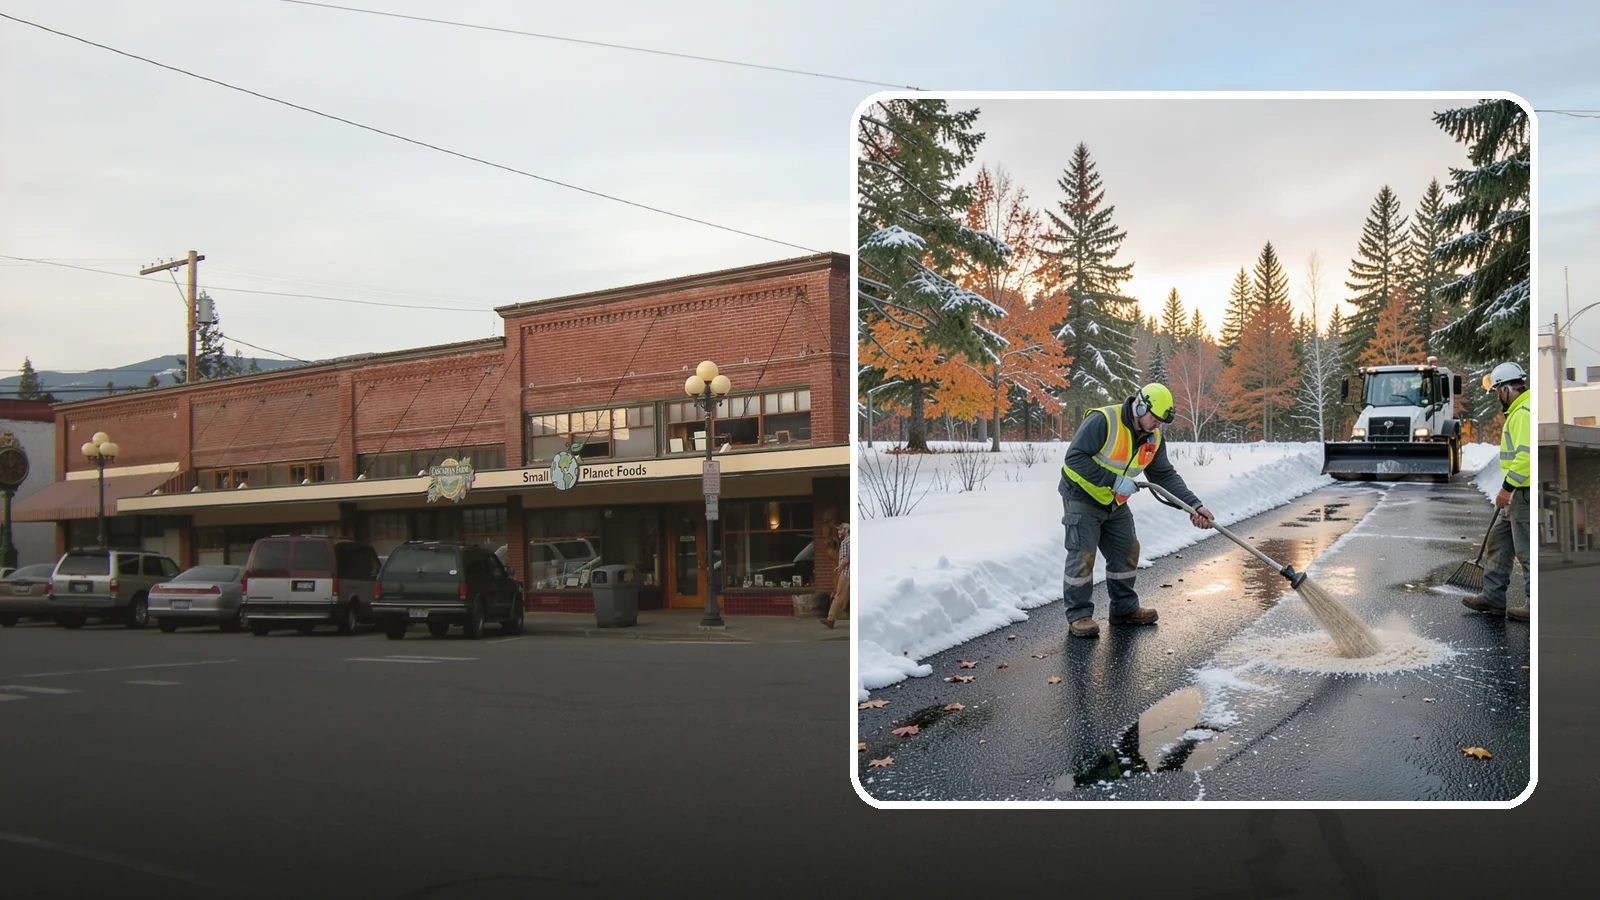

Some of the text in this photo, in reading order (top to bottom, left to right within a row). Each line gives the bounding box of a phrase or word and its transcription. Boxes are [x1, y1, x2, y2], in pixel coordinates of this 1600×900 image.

[431, 466, 456, 476] CASCADIAN
[523, 463, 647, 483] Small Planet Foods
